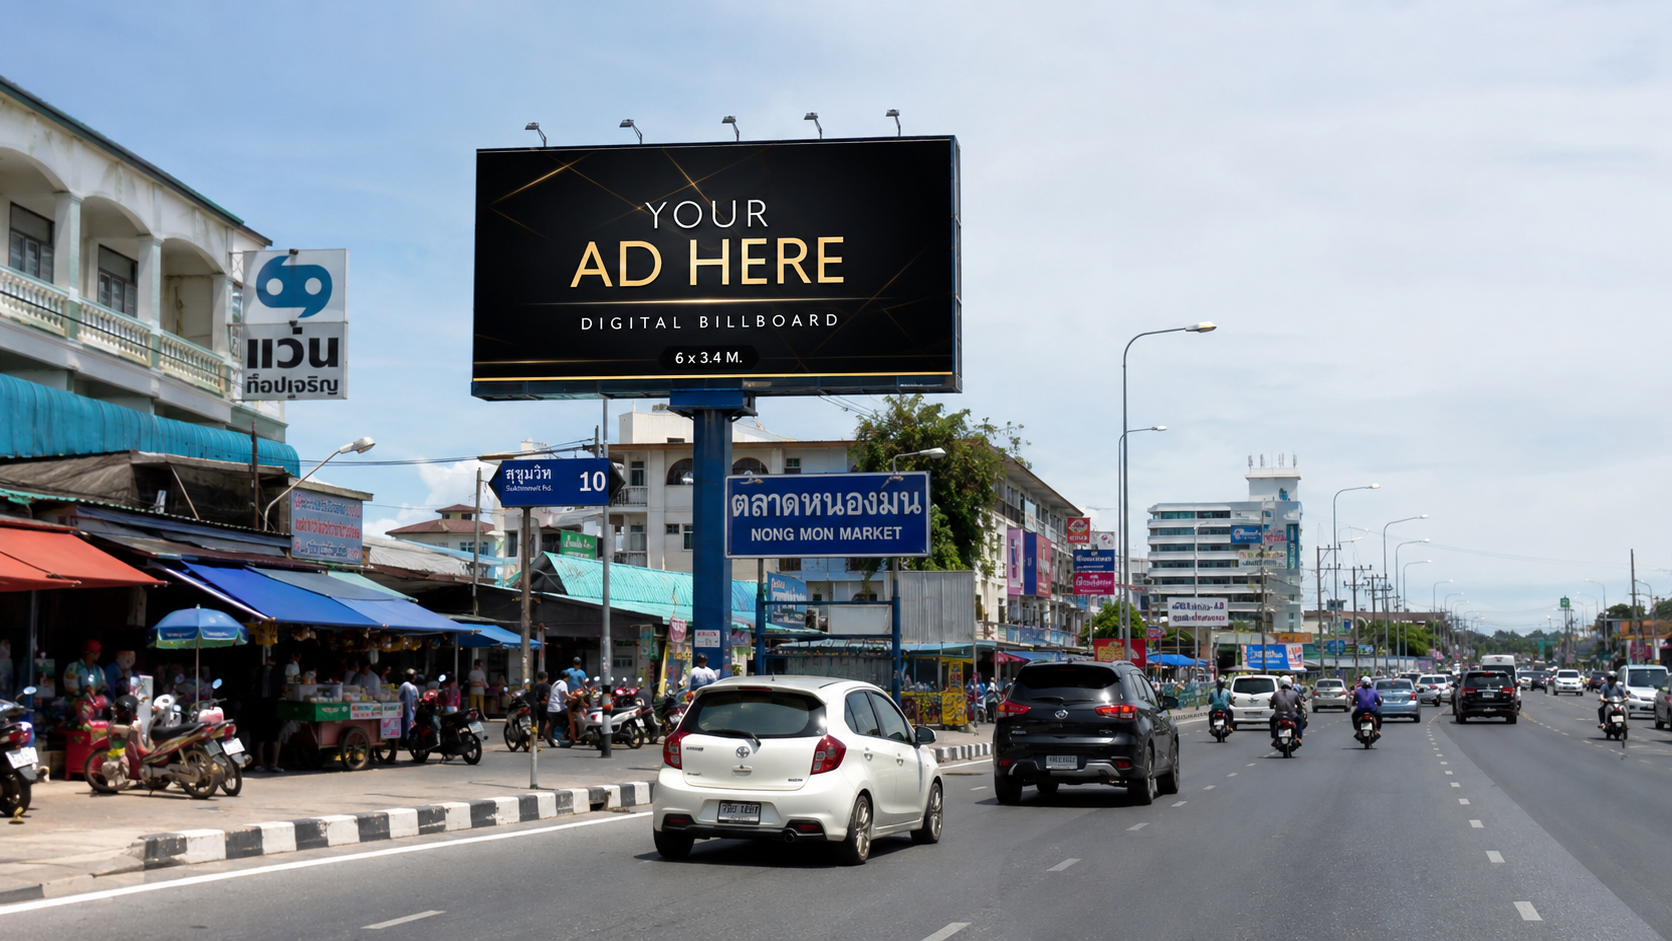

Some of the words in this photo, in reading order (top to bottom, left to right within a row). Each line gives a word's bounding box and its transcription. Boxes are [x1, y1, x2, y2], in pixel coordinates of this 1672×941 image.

[645, 199, 769, 229] YOUR
[570, 240, 662, 288] AD
[689, 236, 844, 286] HERE
[581, 316, 682, 330] DIGITAL
[699, 313, 838, 328] BILLBOARD
[246, 327, 339, 369] แว่น
[675, 352, 684, 364] 6
[688, 355, 696, 364] x
[700, 351, 721, 364] 3.4
[726, 351, 743, 363] M.
[246, 373, 339, 395] ท็อปเจริญ
[579, 471, 606, 492] 10
[731, 491, 922, 517] ตลาดหนองมน
[751, 527, 794, 541] NONG
[800, 527, 834, 540] MON
[839, 526, 902, 540] MARKET
